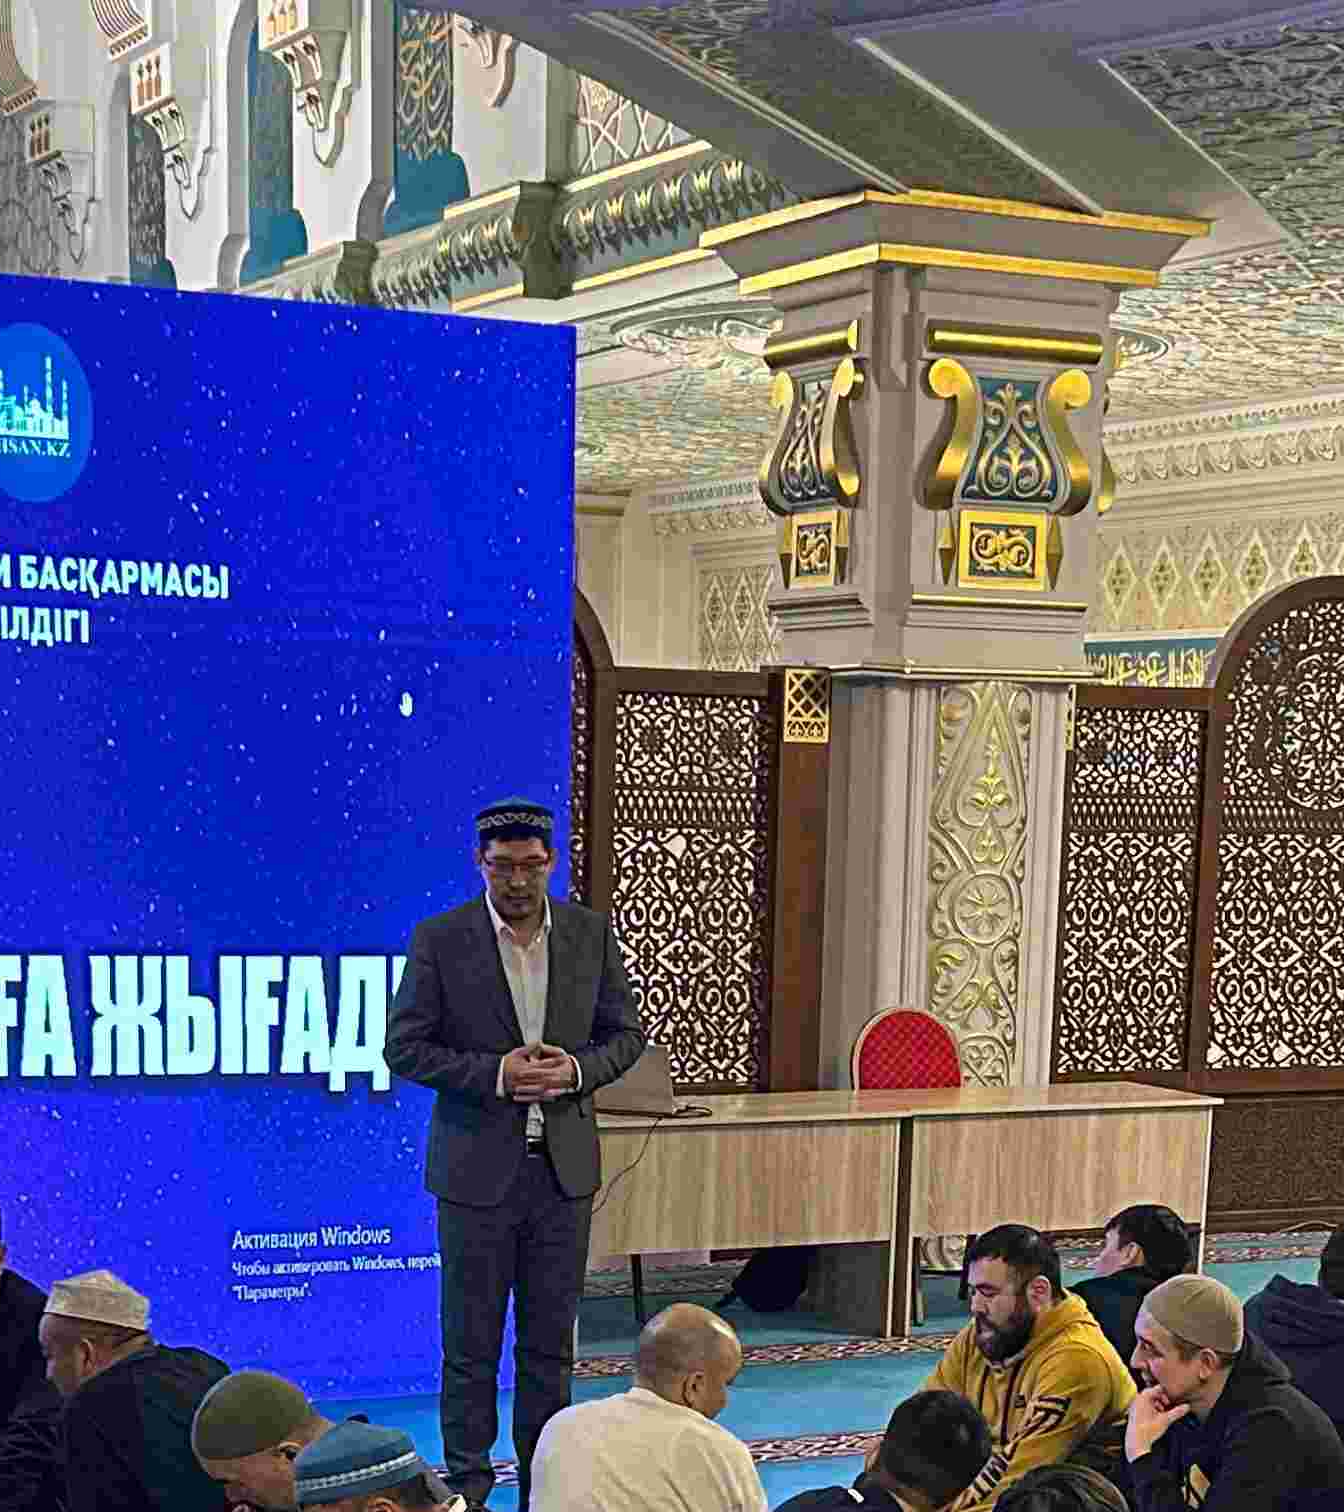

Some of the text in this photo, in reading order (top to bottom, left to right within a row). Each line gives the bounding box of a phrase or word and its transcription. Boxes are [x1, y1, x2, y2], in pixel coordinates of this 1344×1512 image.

[19, 555, 230, 600] БАСҚАРМАСЫ
[88, 954, 408, 1093] ЖЫҒАД
[231, 1224, 392, 1251] Активация Windows
